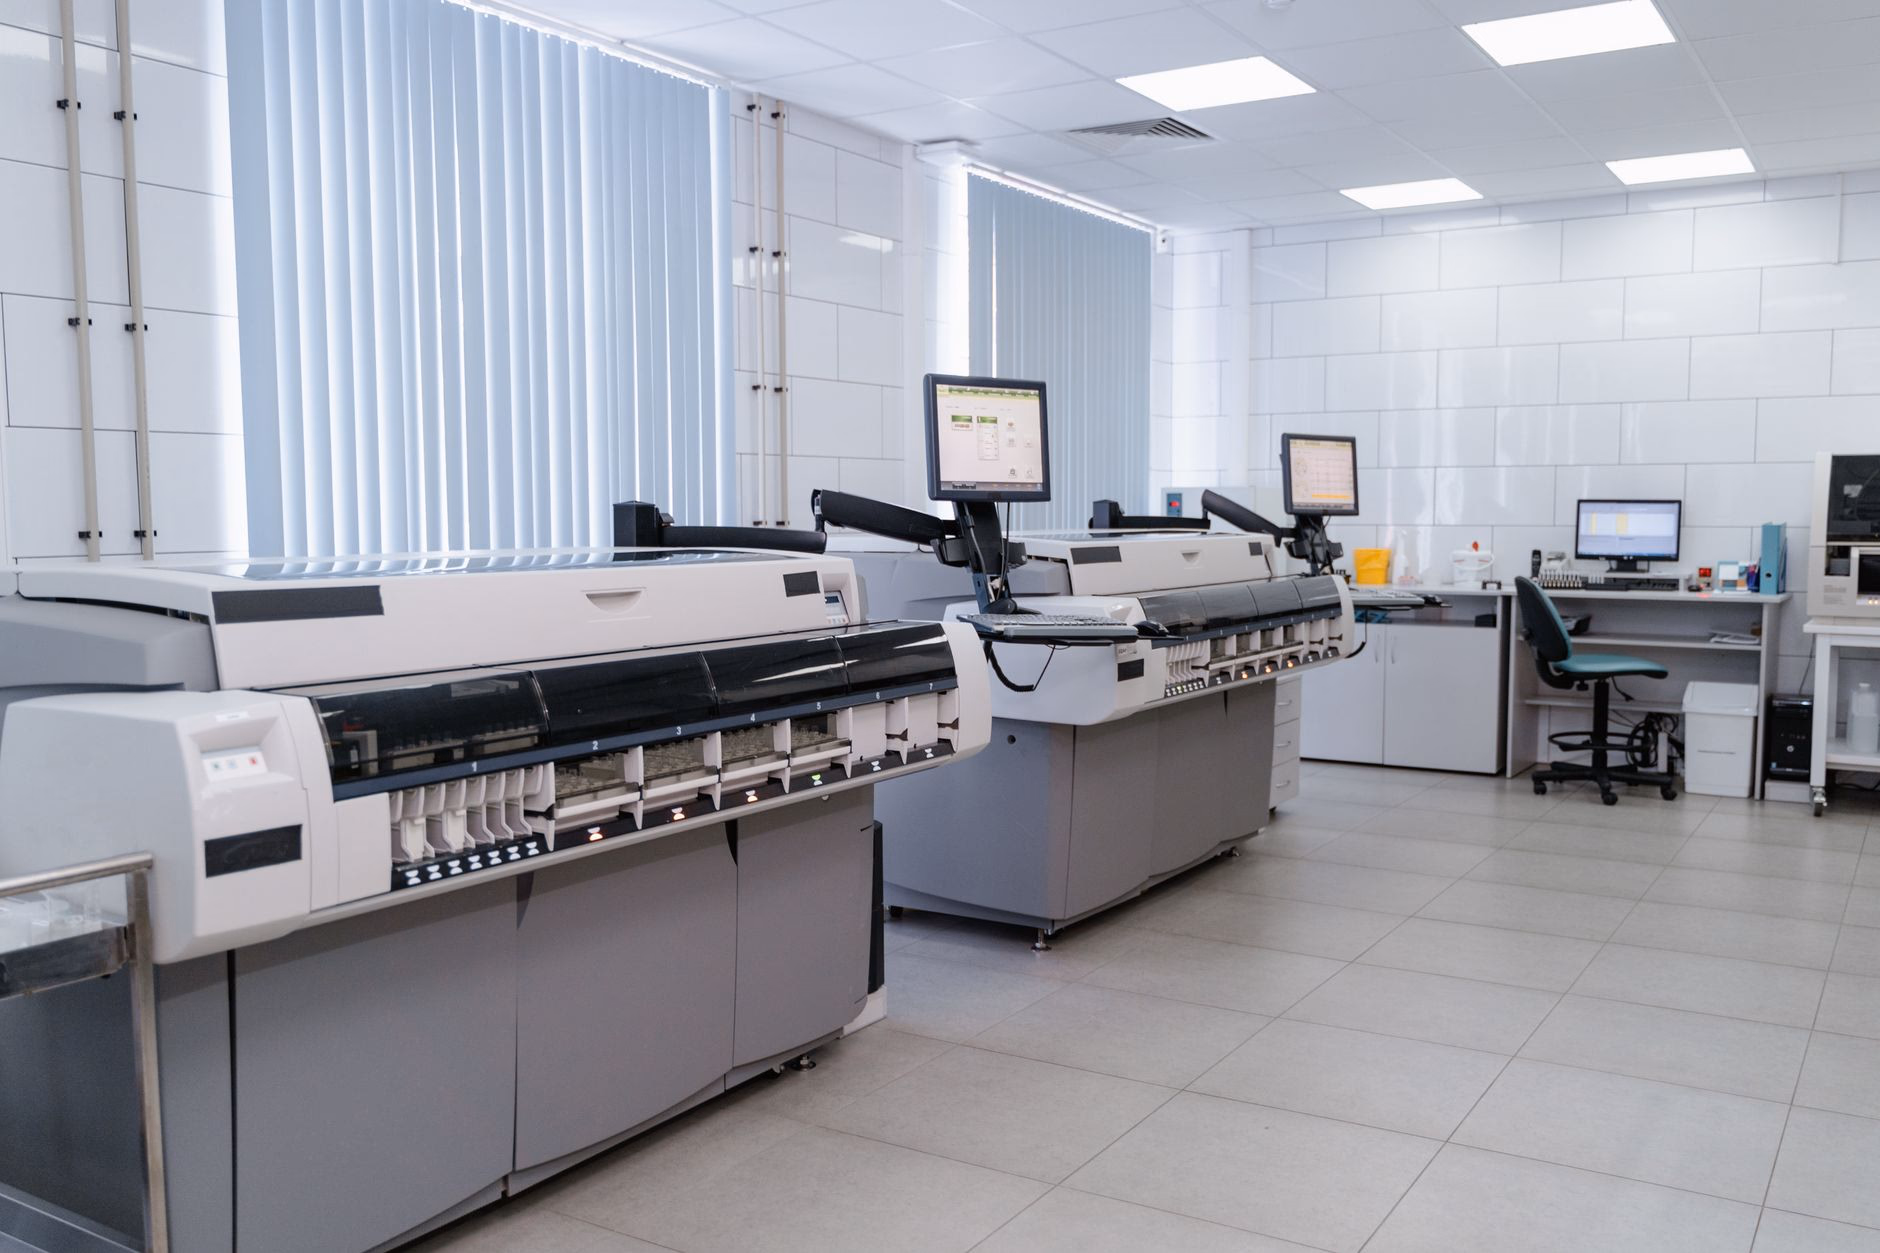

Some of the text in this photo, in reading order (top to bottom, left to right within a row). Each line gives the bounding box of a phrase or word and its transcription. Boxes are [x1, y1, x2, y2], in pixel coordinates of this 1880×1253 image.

[471, 761, 478, 772] 1
[592, 740, 599, 751] 2
[676, 725, 682, 736] 3
